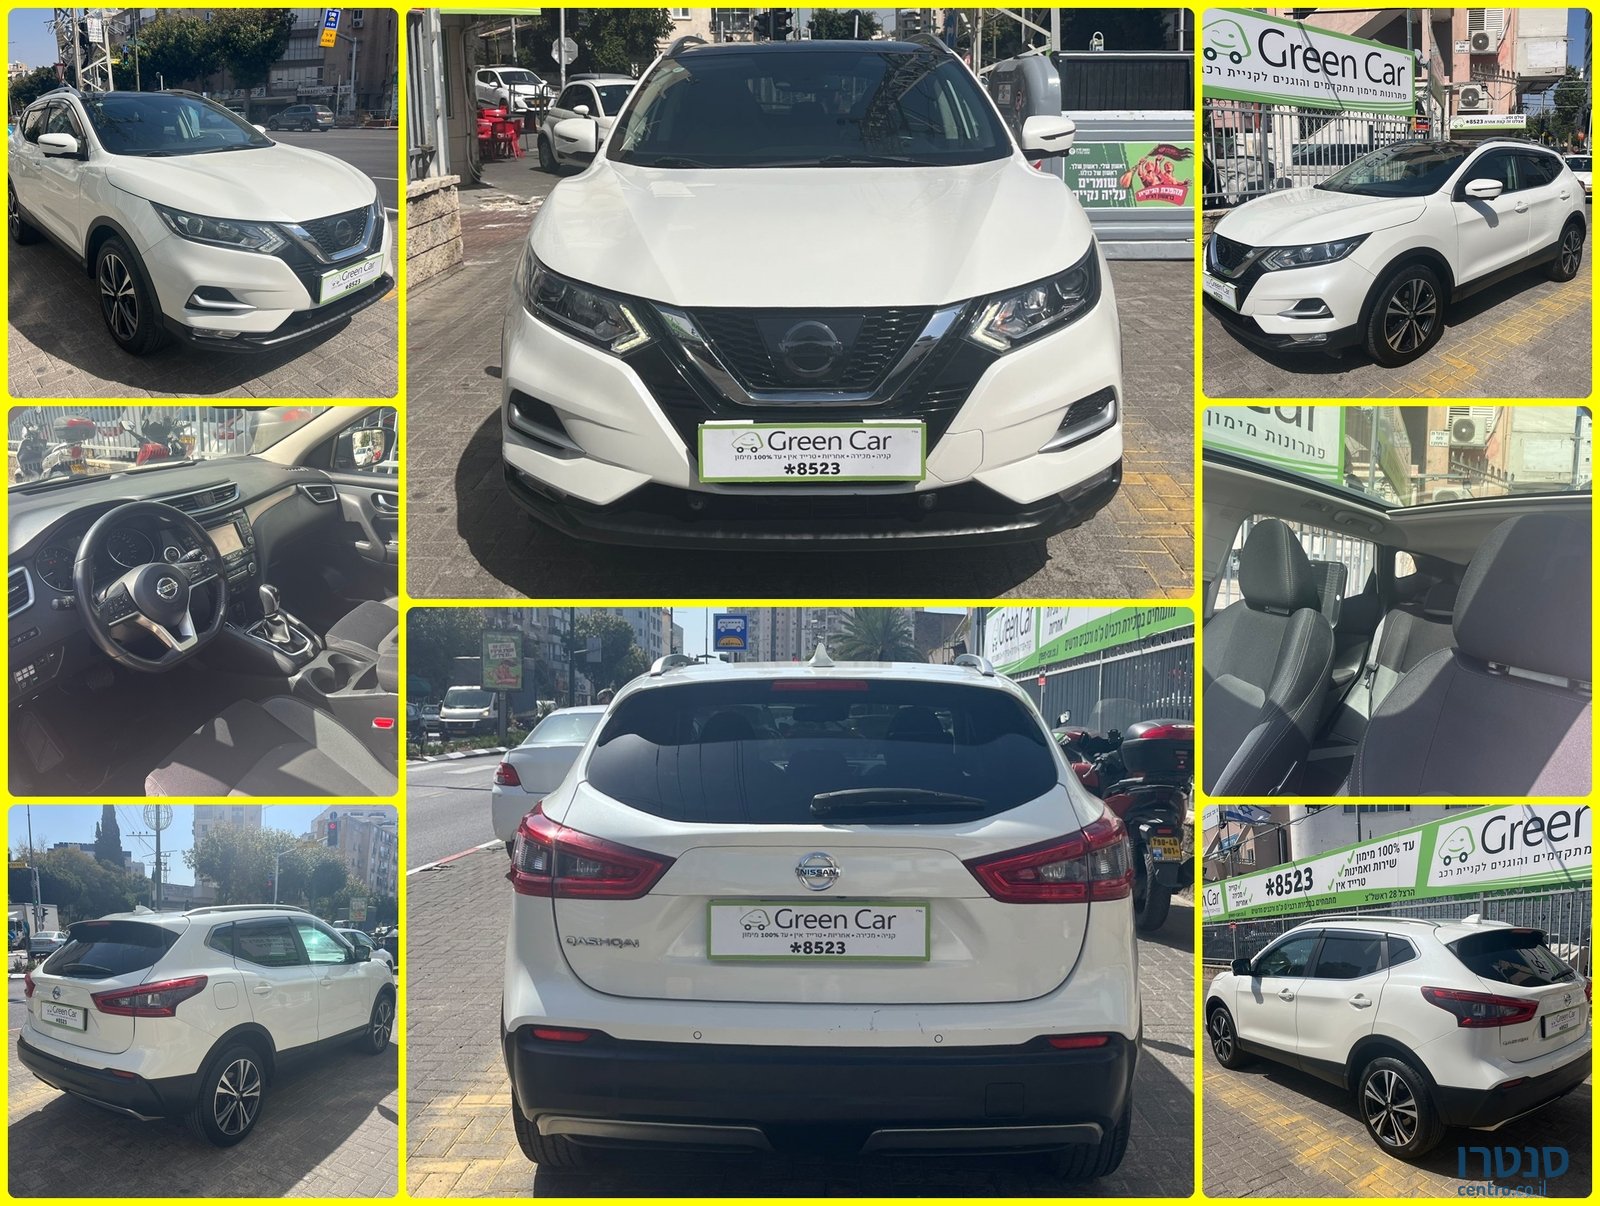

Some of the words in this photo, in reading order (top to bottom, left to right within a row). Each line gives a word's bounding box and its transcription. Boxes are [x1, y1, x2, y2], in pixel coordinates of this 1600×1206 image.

[1258, 28, 1357, 79] Green
[1365, 52, 1405, 87] Car
[1227, 69, 1268, 82] לקניית
[1273, 76, 1310, 88] והוגנים
[1314, 81, 1354, 93] מתקדמים
[1357, 86, 1378, 97] מימון
[1379, 89, 1407, 100] פתרונות
[1078, 178, 1117, 188] שומרים
[1101, 189, 1126, 200] עליה
[342, 266, 363, 281] Green
[363, 261, 375, 272] Car
[1207, 410, 1257, 437] מימון
[768, 431, 842, 451] Green
[849, 430, 892, 451] Car
[1265, 429, 1326, 459] פתרונות
[1379, 842, 1401, 857] 100%
[1403, 840, 1415, 852] עד
[1356, 850, 1376, 864] מימון
[1533, 845, 1592, 863] מתקדמים
[1372, 858, 1397, 872] שירות
[1456, 862, 1487, 875] לקניית
[1491, 856, 1528, 870] והוגנים
[801, 868, 836, 876] NISSAN
[1344, 864, 1371, 877] ואמינות
[1439, 869, 1454, 878] רכב
[1335, 881, 1346, 892] אין
[1347, 877, 1366, 888] טרייד
[1207, 889, 1220, 906] Car
[1389, 889, 1398, 899] 28
[1399, 889, 1415, 897] הרצל
[775, 908, 848, 930] Green
[855, 909, 897, 930] Car
[566, 936, 640, 948] QASHQAI
